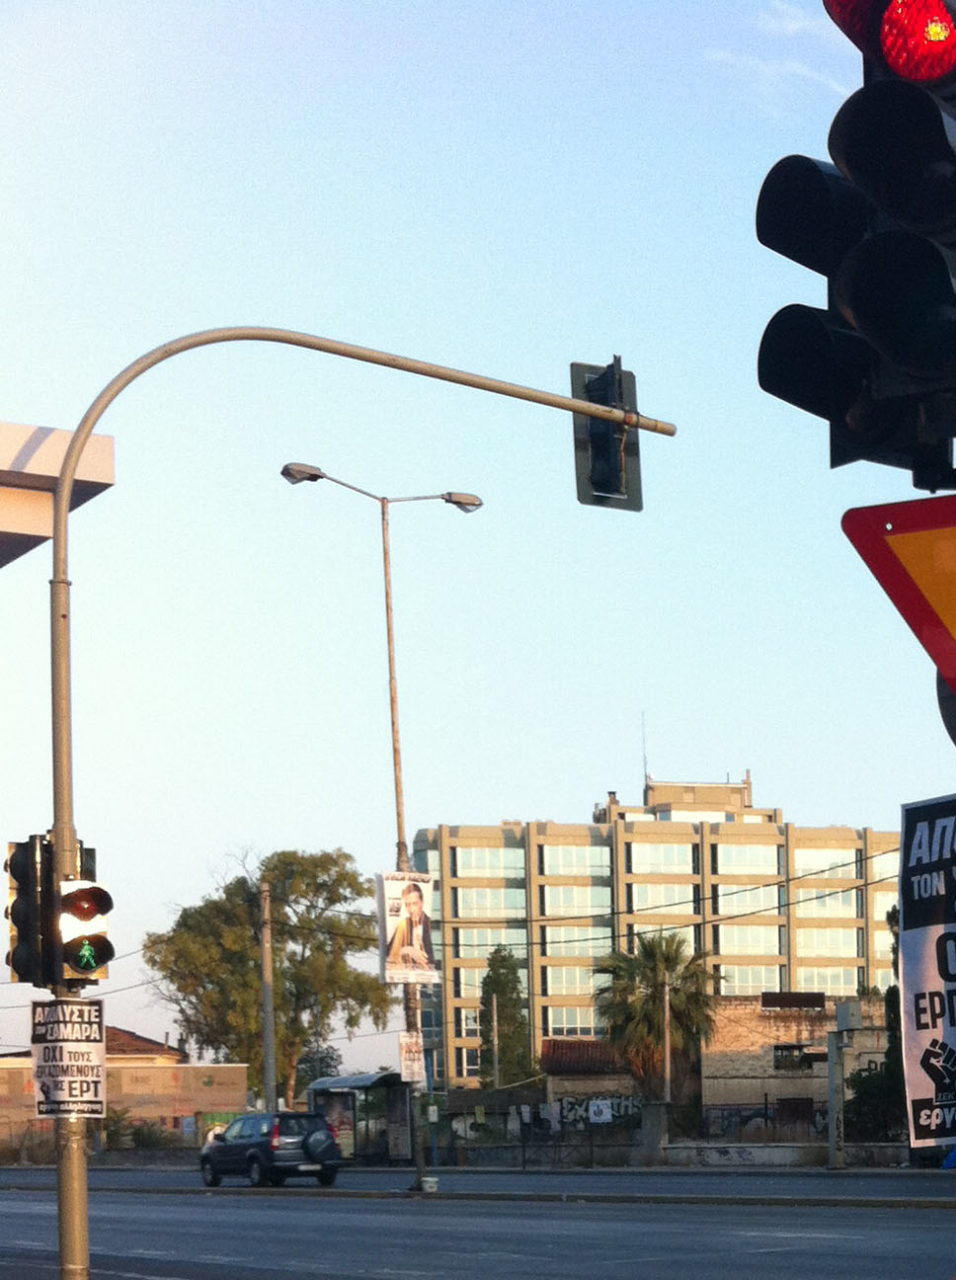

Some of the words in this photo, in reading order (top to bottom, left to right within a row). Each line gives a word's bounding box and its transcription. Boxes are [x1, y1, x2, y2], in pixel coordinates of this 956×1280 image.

[911, 870, 945, 901] ΤΟΝ
[46, 1023, 101, 1040] ΣΑΜΑΡΑ
[43, 1046, 63, 1063] ΟΧΙ
[67, 1051, 93, 1063] ΤΟΥΣ
[68, 1080, 102, 1098] ΕΡΤ
